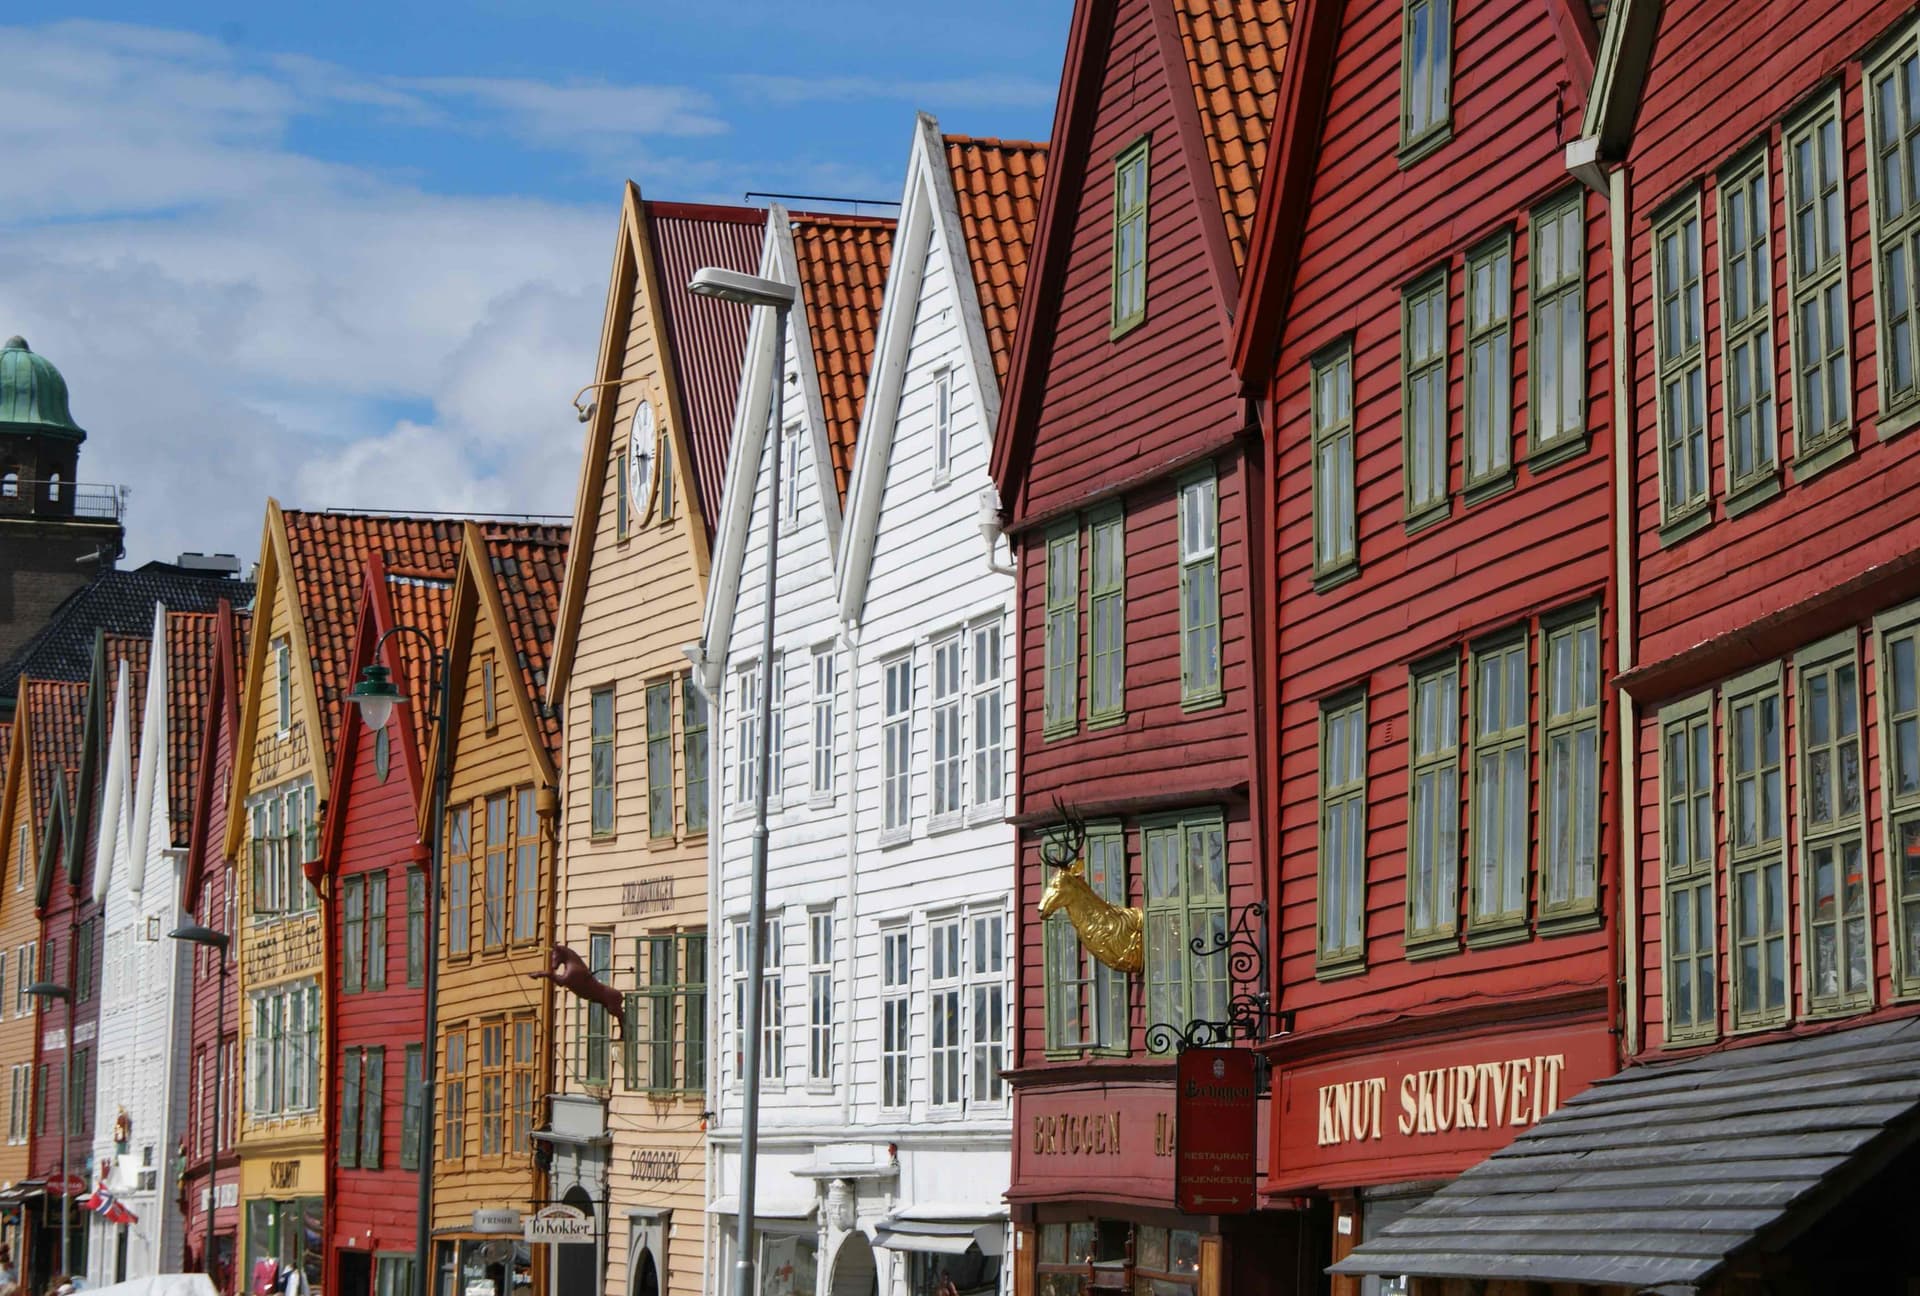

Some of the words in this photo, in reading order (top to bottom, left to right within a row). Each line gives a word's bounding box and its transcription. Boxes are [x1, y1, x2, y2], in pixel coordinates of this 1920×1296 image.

[1318, 1077, 1386, 1146] KNUT
[1398, 1054, 1565, 1136] SKURTVEIT
[1032, 1111, 1121, 1155] BRYGGEN
[1184, 1152, 1249, 1160] RESTAURANT
[1181, 1176, 1253, 1184] SKJENKESTUE
[530, 1219, 544, 1234] To
[546, 1219, 590, 1234] Kokker
